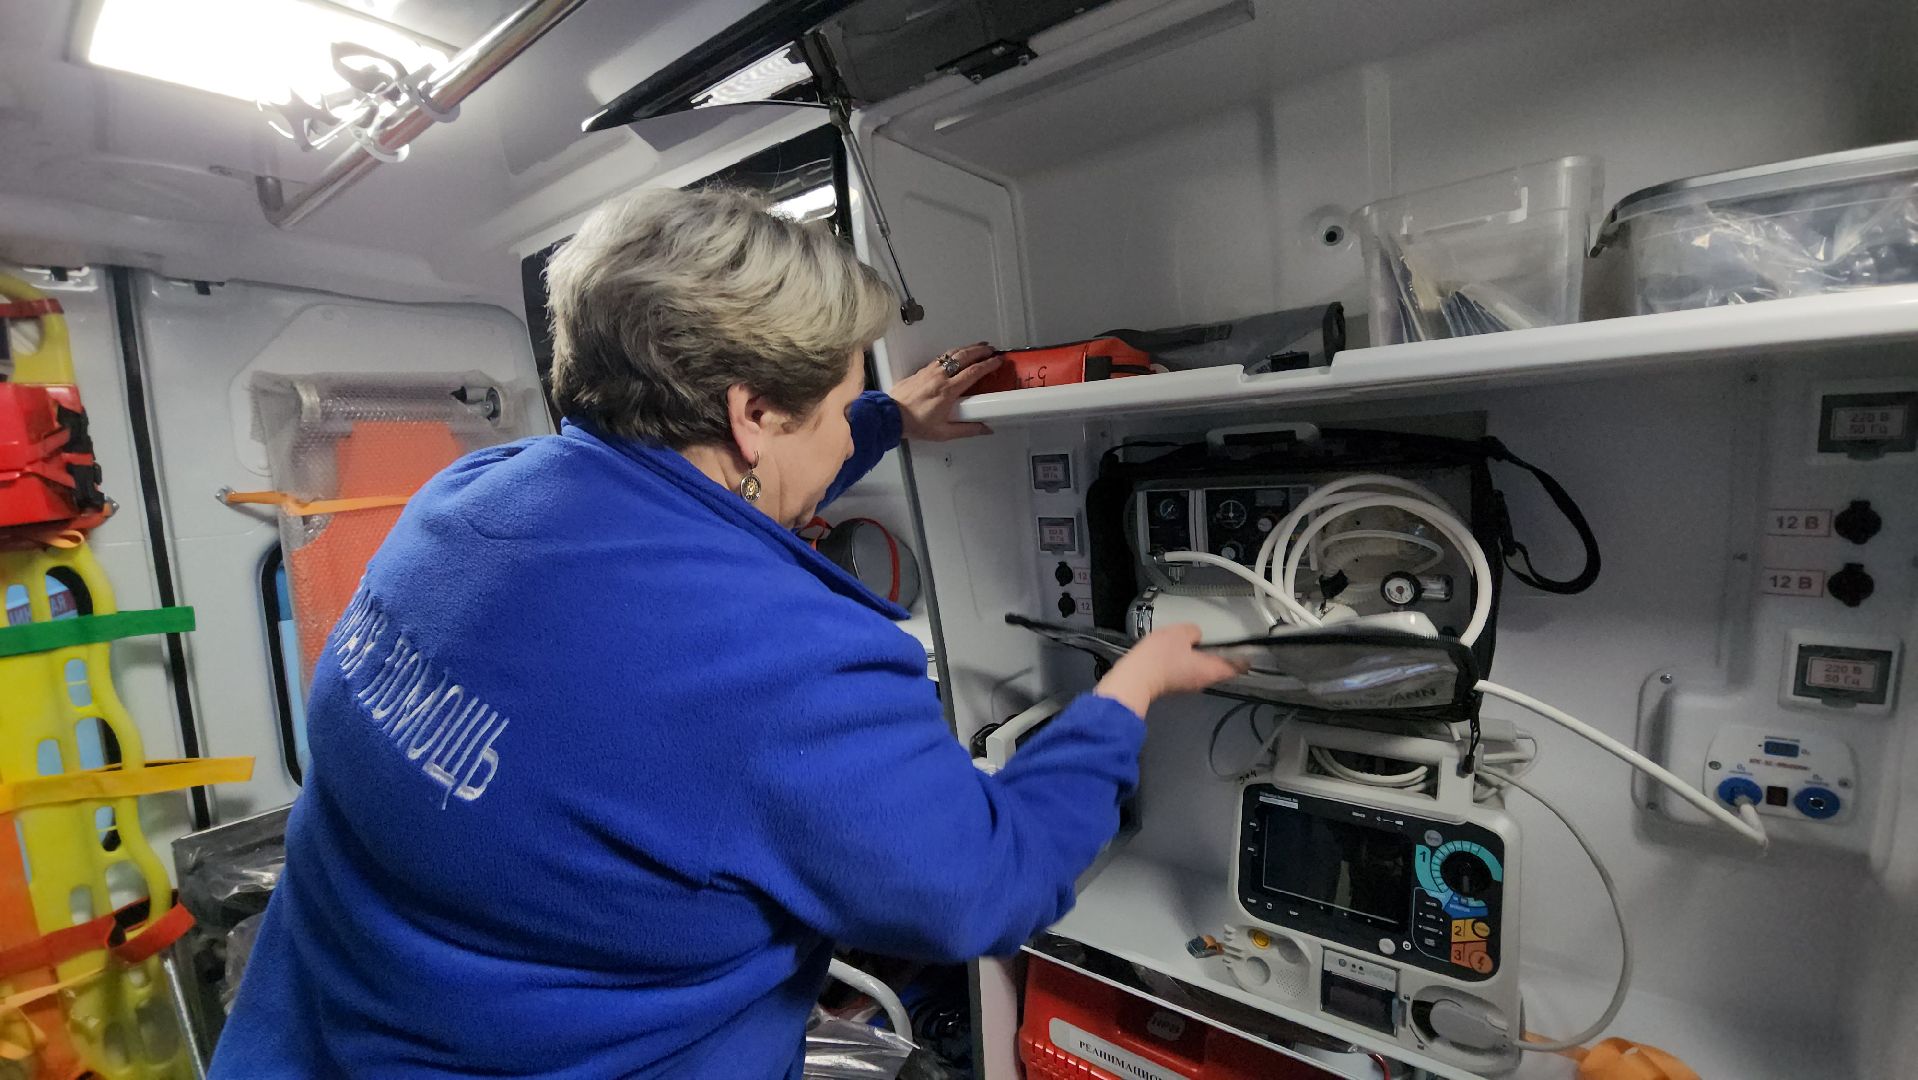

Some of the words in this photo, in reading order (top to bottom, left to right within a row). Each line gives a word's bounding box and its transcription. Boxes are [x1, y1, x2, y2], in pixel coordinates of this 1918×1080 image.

[1776, 515, 1798, 530] 12
[1804, 516, 1819, 530] В
[1077, 571, 1088, 582] 12
[1769, 575, 1791, 589] 12
[1798, 576, 1812, 589] В
[1080, 602, 1091, 611] 12
[1825, 664, 1849, 674] 220
[358, 633, 510, 810] ПОМОЩЬ
[1419, 850, 1427, 862] 1
[1454, 925, 1463, 937] 2
[1454, 950, 1462, 961] 3
